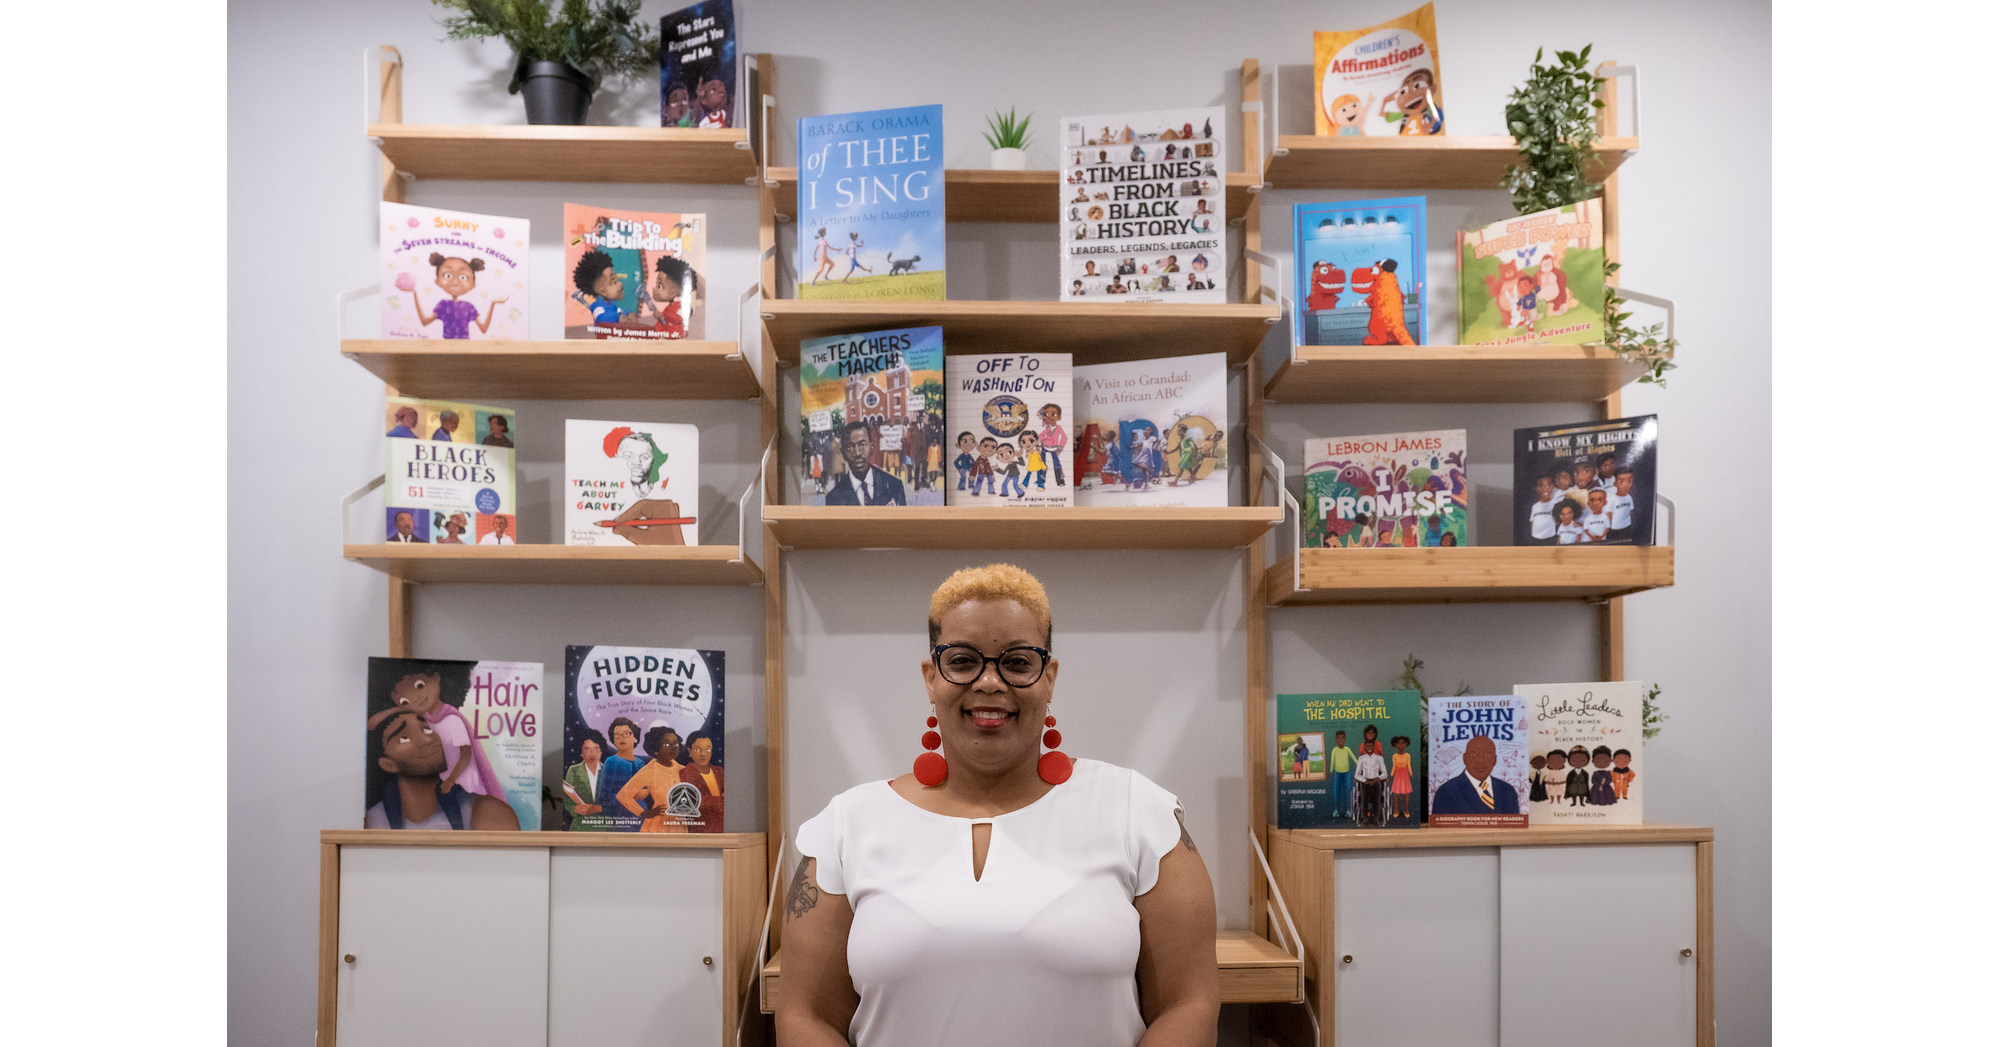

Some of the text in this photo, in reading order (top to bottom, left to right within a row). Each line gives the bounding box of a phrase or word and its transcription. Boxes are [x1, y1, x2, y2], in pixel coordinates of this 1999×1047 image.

[677, 16, 715, 36] The Stars
[668, 28, 724, 52] Represent You
[1355, 35, 1400, 55] CHILDREN'S
[681, 46, 713, 64] and Me
[1332, 43, 1425, 74] Affirmations
[808, 114, 930, 137] BARACK OBAMA
[807, 133, 930, 178] of THEE
[1086, 160, 1201, 183] TIMELINES
[808, 170, 930, 210] I SING
[1114, 182, 1174, 201] FROM
[810, 209, 931, 226] A Letter to My Daughters
[1109, 200, 1179, 220] BLACK
[433, 216, 479, 232] SUNNY
[609, 218, 661, 234] Trip To
[1098, 219, 1191, 239] HISTORY
[1529, 222, 1592, 244] POWER
[402, 238, 432, 250] SEVEN
[434, 238, 475, 249] STREAMS
[485, 247, 517, 269] INCOME
[584, 229, 683, 258] The Building
[1071, 240, 1218, 255] LEADERS, LEGENDS, LEGACIES
[865, 287, 900, 298] LOREN
[904, 286, 936, 295] LONG
[587, 326, 612, 335] Written
[613, 327, 622, 337] by
[624, 329, 646, 337] James
[648, 330, 669, 338] Morris
[1505, 323, 1591, 345] Jungle Adventure
[812, 353, 828, 364] THE
[827, 334, 911, 361] TEACHERS
[838, 352, 899, 377] MARCH!
[976, 355, 1040, 373] OFF TO
[962, 374, 1055, 394] WASHINGTON
[1083, 371, 1191, 392] A Visit to Grandad:
[1092, 386, 1183, 405] An African ABC
[1393, 438, 1442, 453] JAMES
[1528, 440, 1533, 452] I
[1538, 436, 1571, 451] KNOW
[1576, 434, 1594, 447] MY
[1555, 445, 1615, 458] Bill of Rights
[415, 444, 487, 467] BLACK
[407, 461, 496, 484] HEROES
[1375, 470, 1391, 492] I
[408, 486, 424, 498] 51
[572, 479, 625, 489] TEACH ME
[582, 490, 618, 499] ABOUT
[576, 501, 625, 511] GARVEY
[1318, 490, 1454, 520] PROMISE
[593, 655, 696, 680] HIDDEN
[474, 672, 539, 708] Hair
[591, 677, 701, 702] FIGURES
[621, 700, 635, 708] Story
[657, 700, 672, 708] Black
[674, 703, 694, 713] Women
[640, 707, 657, 715] Space
[1304, 707, 1391, 720] THE HOSPITAL
[1306, 700, 1325, 708] WHEN
[1327, 699, 1336, 707] MY
[1355, 699, 1373, 707] WENT
[1467, 700, 1495, 708] STORY
[1536, 691, 1623, 721] Little Leaders
[474, 709, 537, 740] Love
[1442, 708, 1514, 724] JOHN
[1443, 723, 1514, 743] LEWIS
